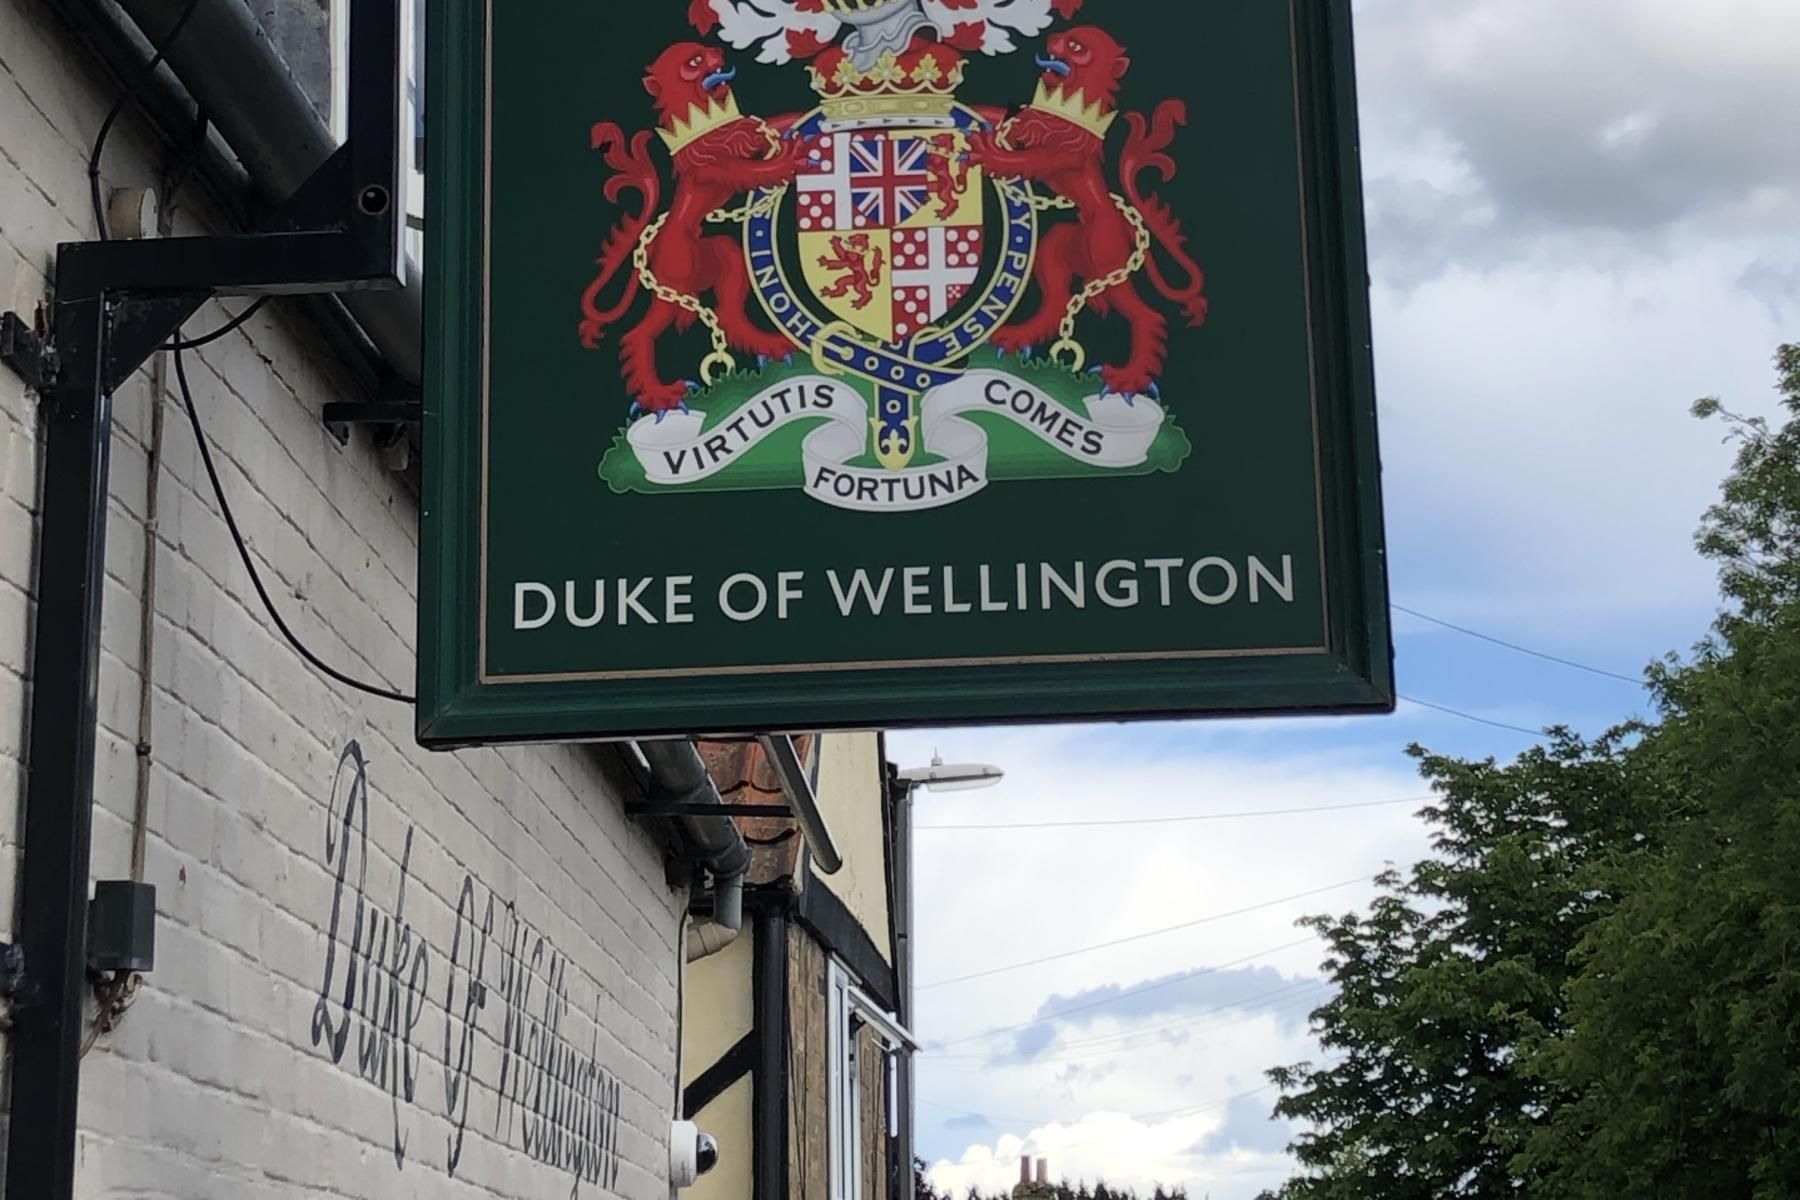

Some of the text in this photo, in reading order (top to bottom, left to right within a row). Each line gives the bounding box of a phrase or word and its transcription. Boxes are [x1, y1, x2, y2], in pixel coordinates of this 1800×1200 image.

[751, 249, 812, 338] HONI
[938, 250, 1027, 357] PENSE
[663, 379, 1104, 502] VIRTUTIS FORTUNA COMES
[514, 554, 1293, 630] DUKE OF WELLINGTON
[312, 739, 429, 1171] Duke
